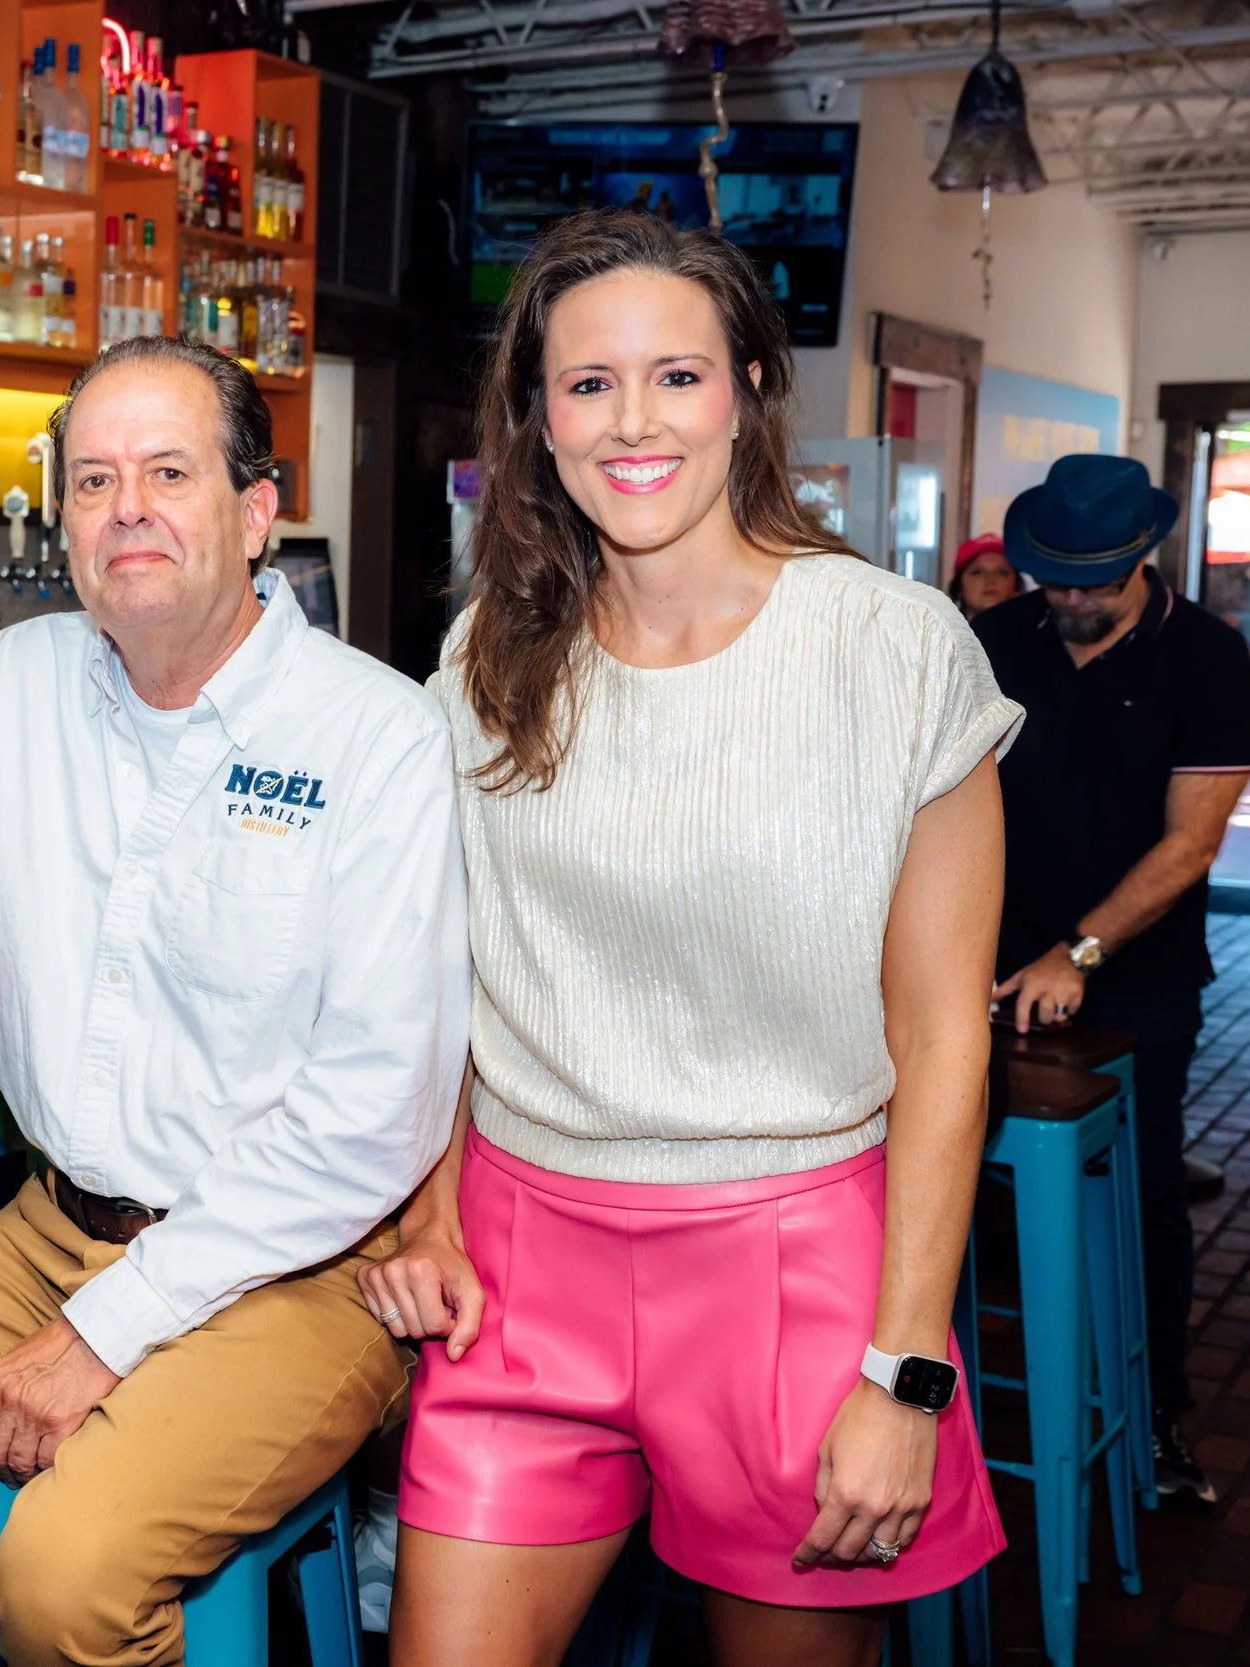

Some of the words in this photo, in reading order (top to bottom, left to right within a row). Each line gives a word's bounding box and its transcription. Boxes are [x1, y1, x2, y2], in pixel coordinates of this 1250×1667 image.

[224, 763, 326, 810] NOËL
[227, 803, 312, 830] FAMILY
[240, 818, 291, 837] DISTILLERY
